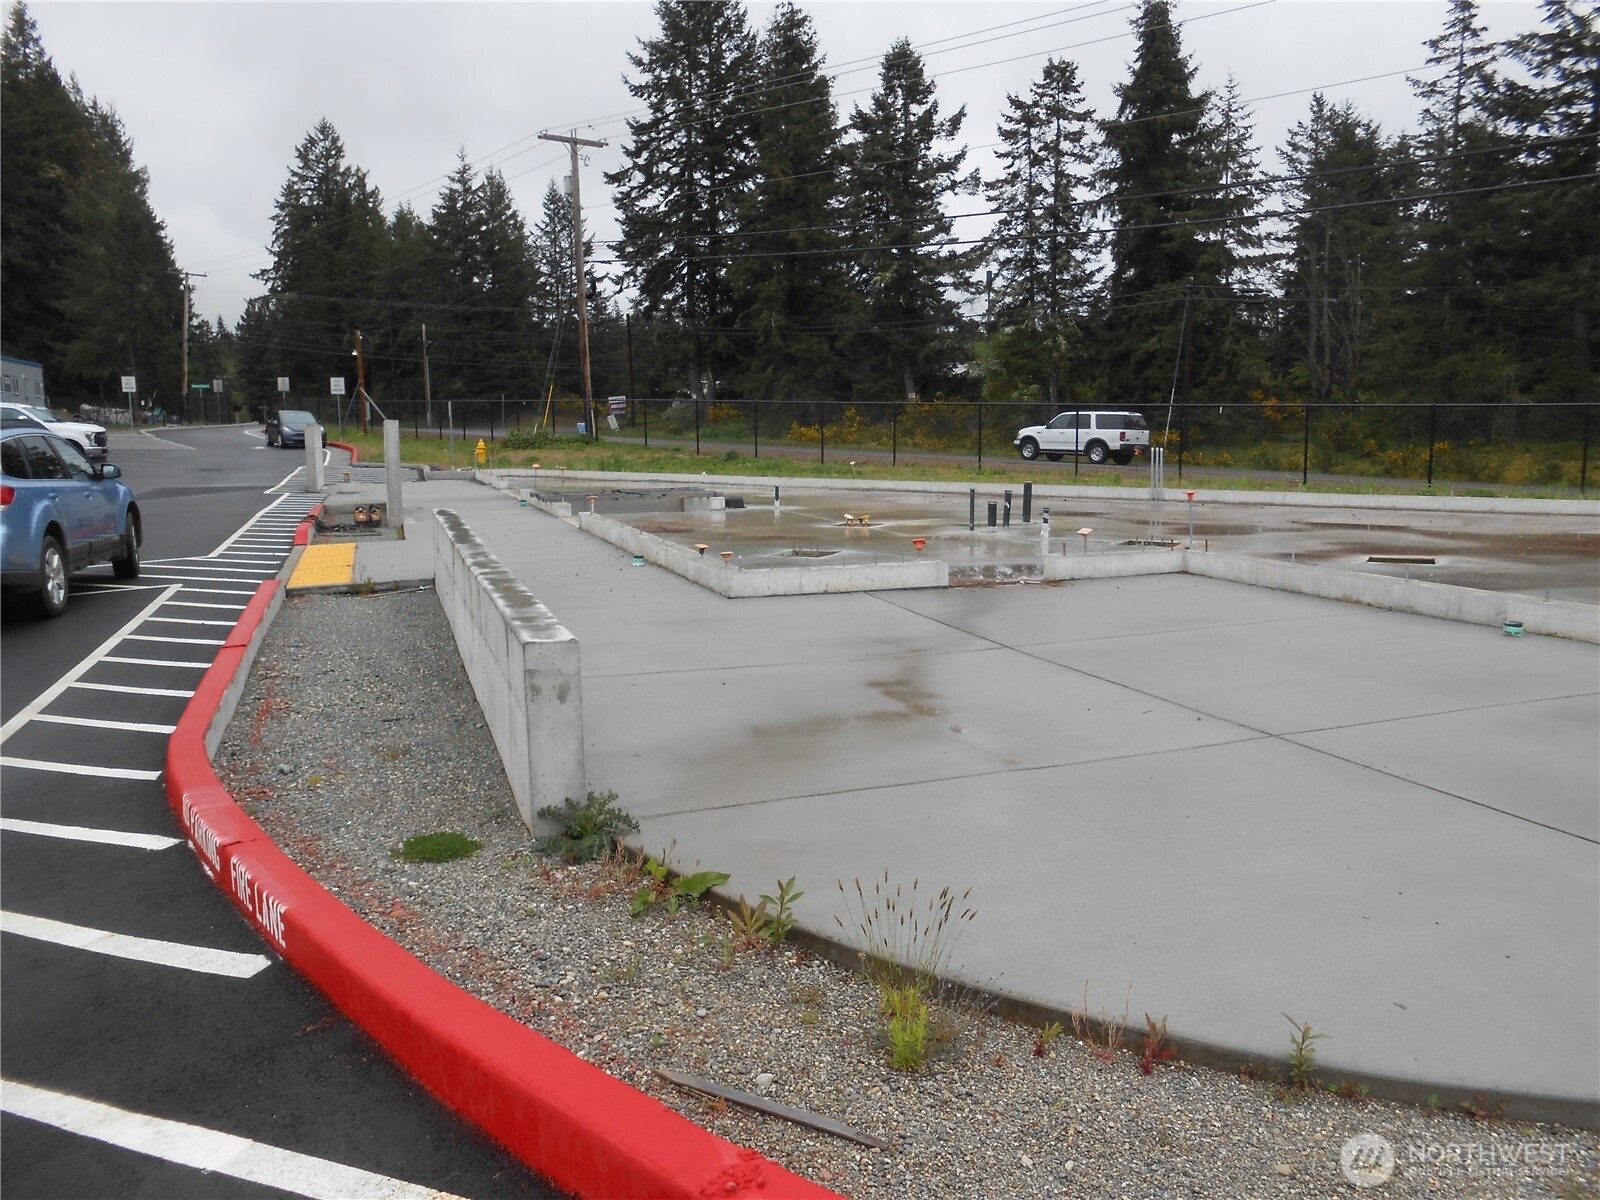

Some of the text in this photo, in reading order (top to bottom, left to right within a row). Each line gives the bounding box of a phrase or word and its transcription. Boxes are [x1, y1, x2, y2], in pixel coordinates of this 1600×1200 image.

[191, 807, 220, 872] PARKING
[231, 855, 253, 912] FIRE
[254, 881, 288, 949] LANE
